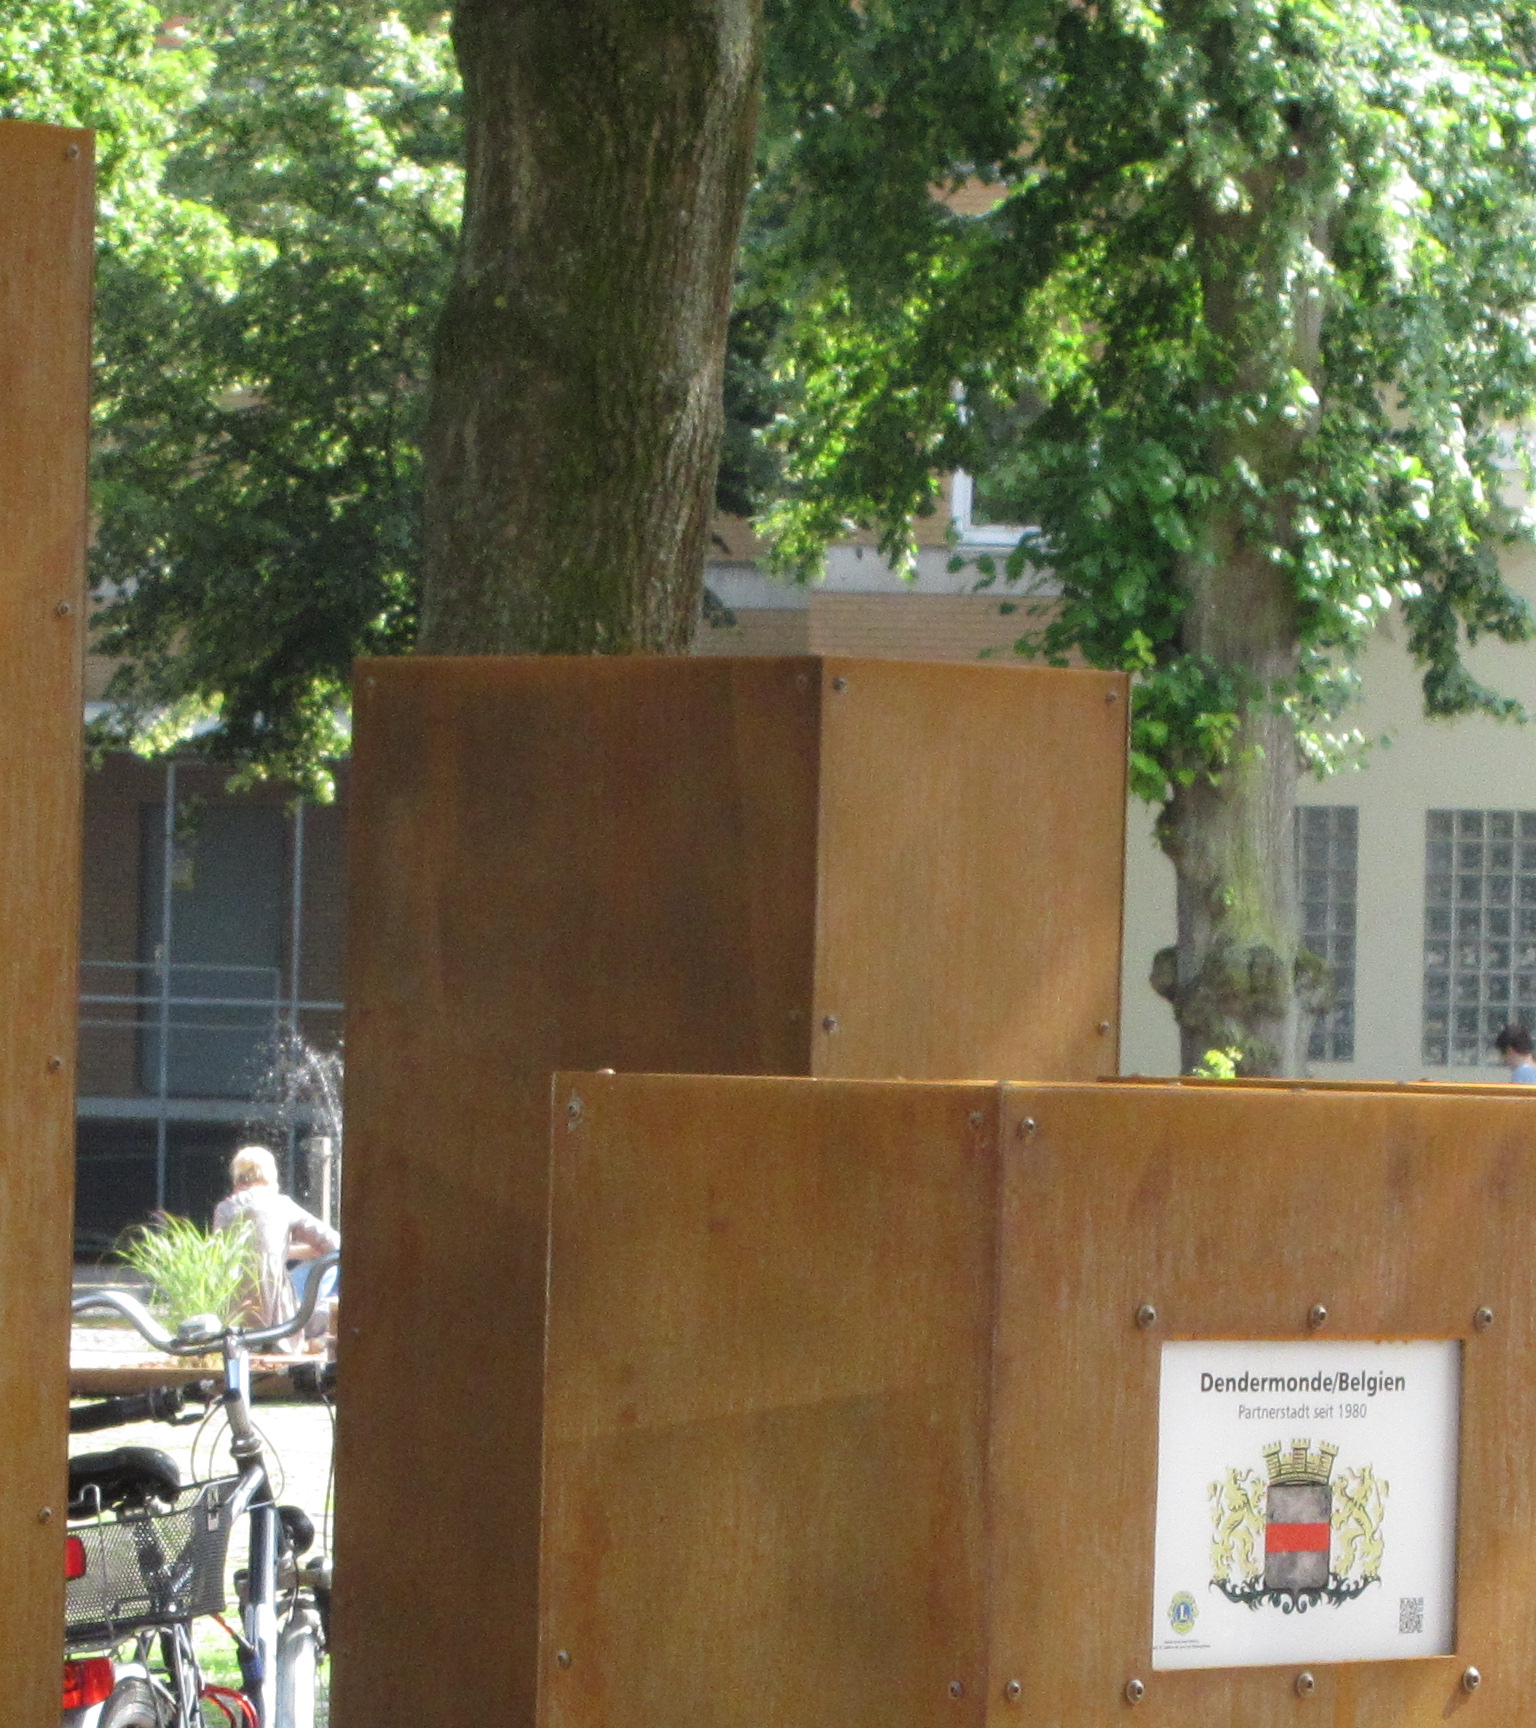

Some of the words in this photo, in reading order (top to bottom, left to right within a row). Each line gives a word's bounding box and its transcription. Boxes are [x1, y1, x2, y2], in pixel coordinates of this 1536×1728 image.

[1200, 1370, 1406, 1397] Dendermonde/Belgien
[1238, 1404, 1310, 1419] Partnerstadt
[1314, 1404, 1334, 1419] seit
[1339, 1403, 1368, 1419] 1980
